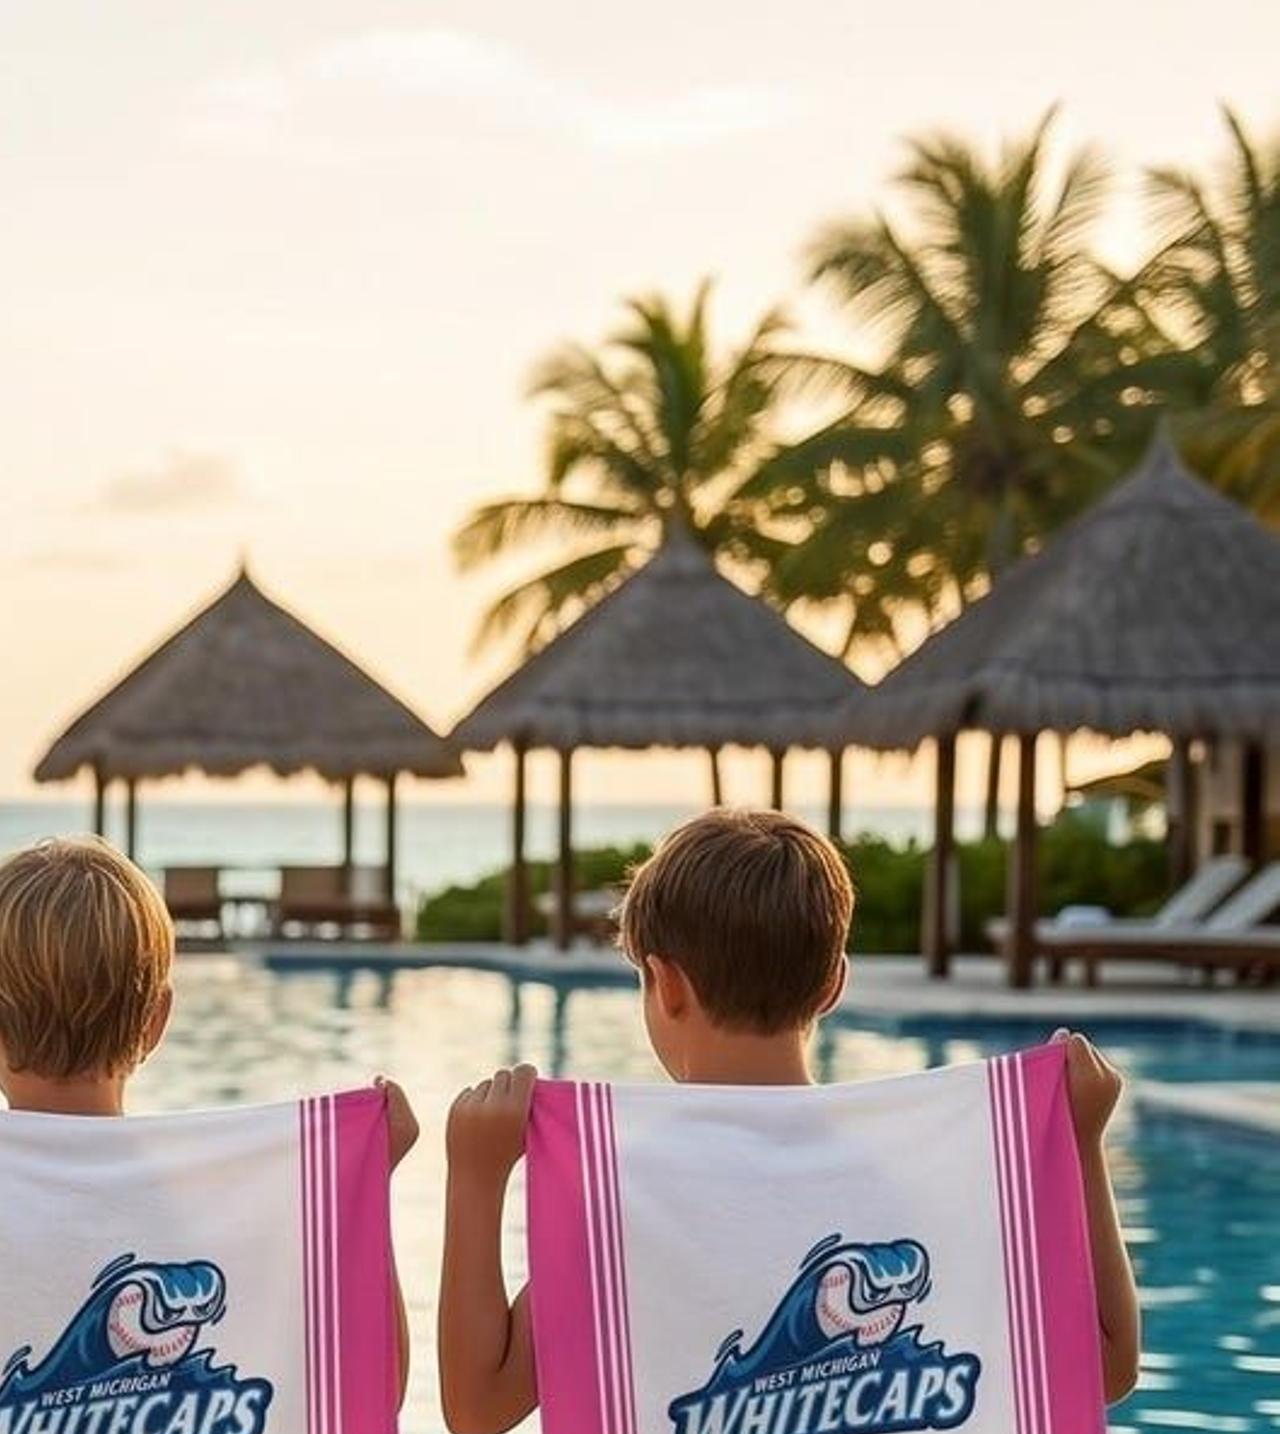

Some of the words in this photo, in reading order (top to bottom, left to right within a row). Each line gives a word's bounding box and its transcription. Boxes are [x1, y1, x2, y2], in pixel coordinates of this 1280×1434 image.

[41, 1386, 85, 1407] WEST
[89, 1373, 171, 1398] MICHIGAN
[754, 1370, 796, 1393] WEST
[800, 1350, 882, 1382] MICHIGAN
